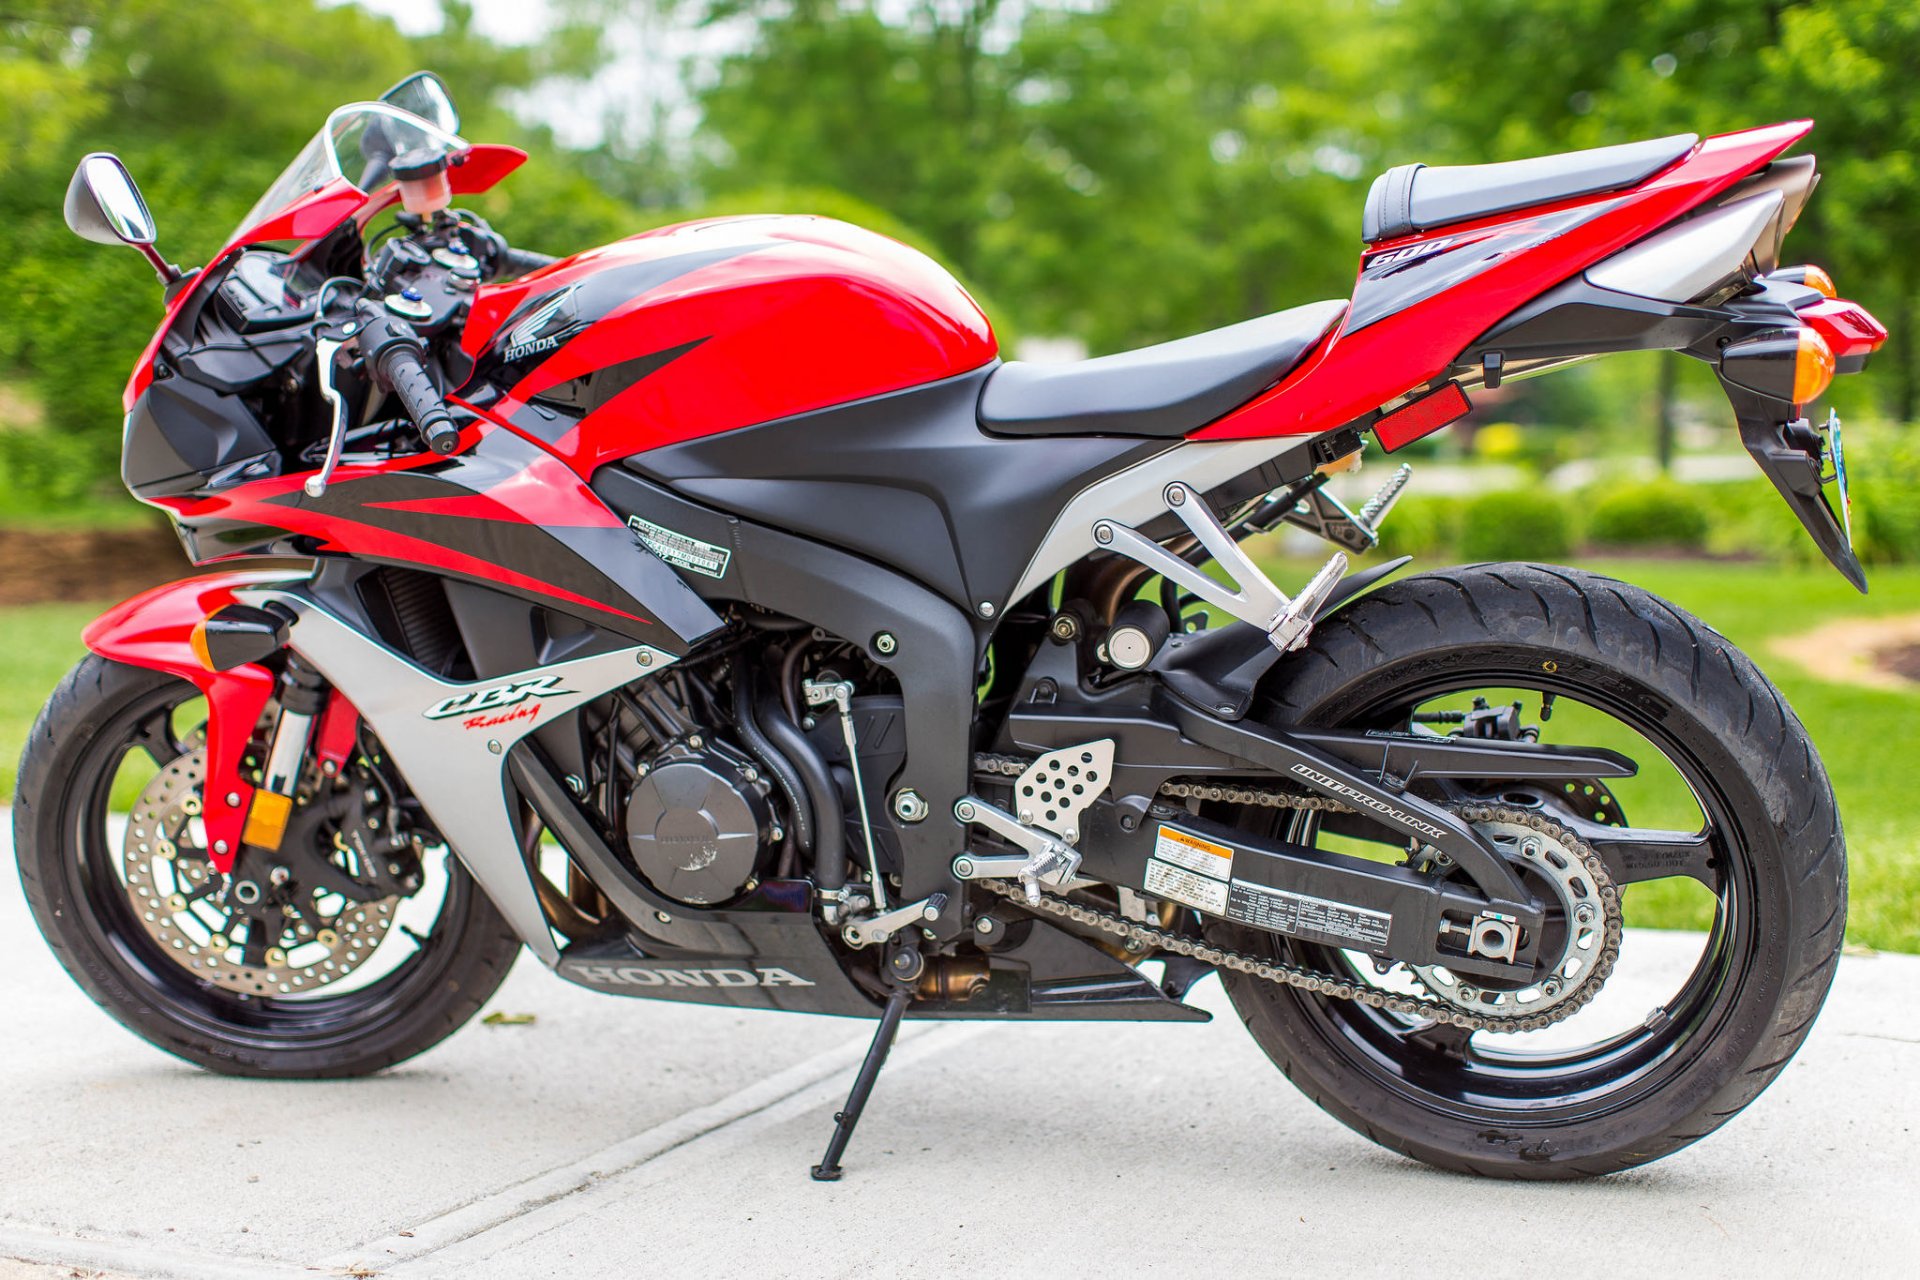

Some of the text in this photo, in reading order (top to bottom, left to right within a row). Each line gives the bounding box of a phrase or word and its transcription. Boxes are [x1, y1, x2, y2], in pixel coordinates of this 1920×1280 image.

[1366, 238, 1453, 269] 600
[503, 335, 559, 363] HONDA
[422, 674, 581, 720] CBR
[463, 703, 542, 730] Racing
[1291, 763, 1448, 839] UNIT PRO-LINK
[1185, 838, 1211, 851] WARNING
[570, 965, 816, 987] HONDA
